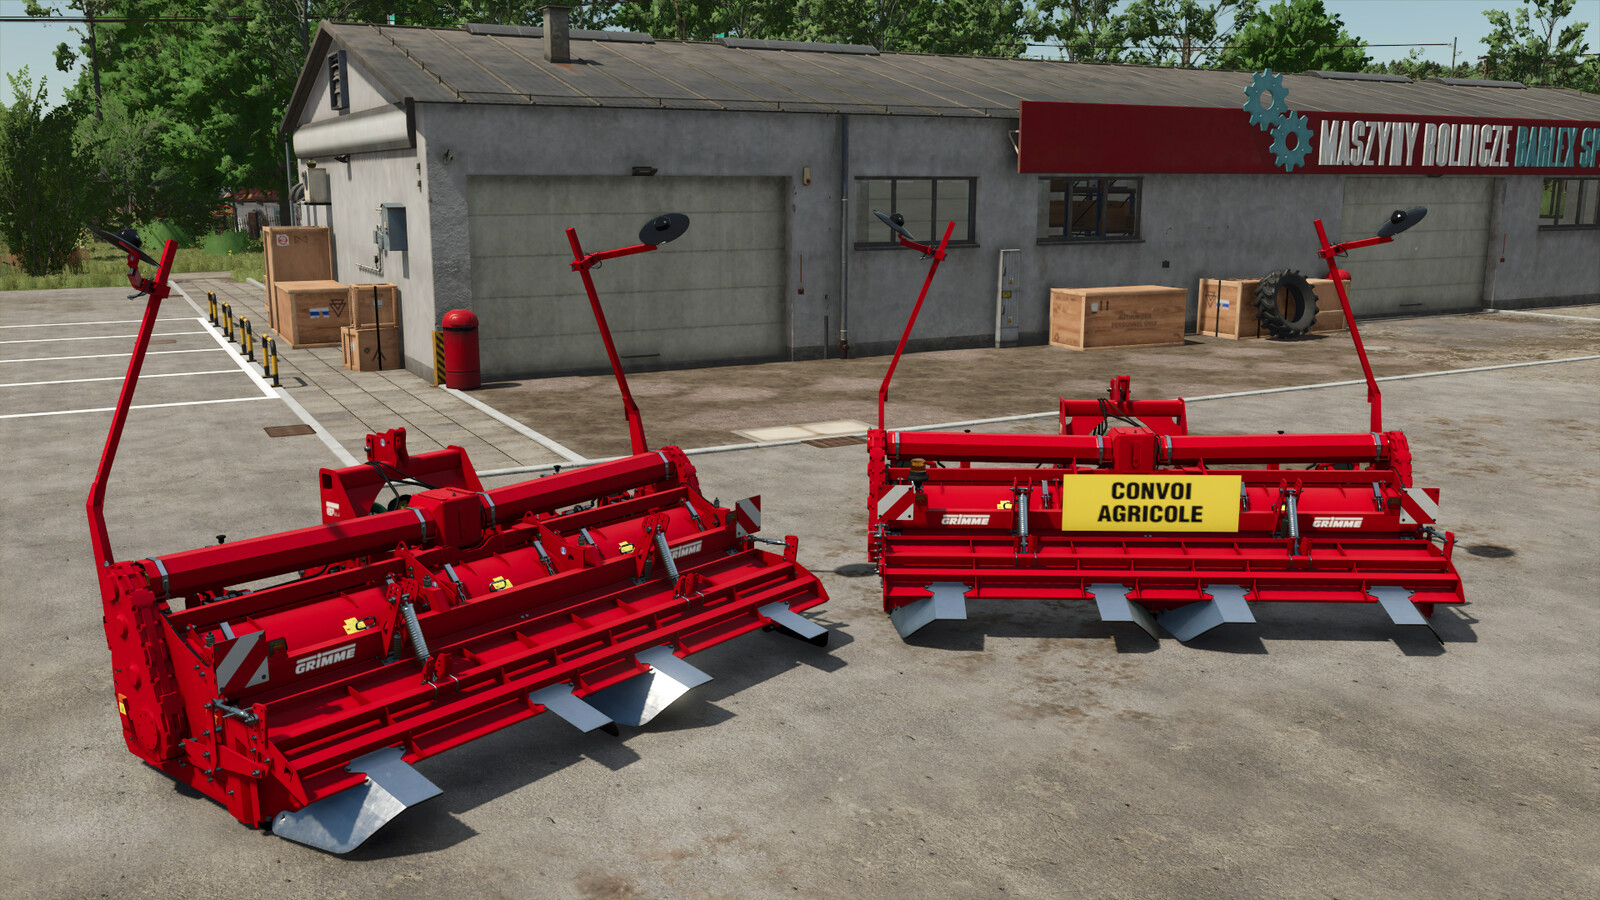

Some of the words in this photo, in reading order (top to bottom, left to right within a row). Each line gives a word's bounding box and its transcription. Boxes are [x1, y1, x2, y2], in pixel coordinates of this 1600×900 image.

[1318, 119, 1420, 167] MASZYNY
[1421, 122, 1513, 168] ROLNICZE
[1513, 125, 1579, 168] BARLEX
[1579, 126, 1600, 168] SP
[1111, 482, 1192, 500] CONVOI
[941, 514, 991, 526] GRIMME
[1097, 505, 1204, 523] AGRICOLE
[1312, 517, 1364, 529] GRIMME
[670, 541, 703, 560] RIMME
[294, 644, 356, 675] GRIMME
